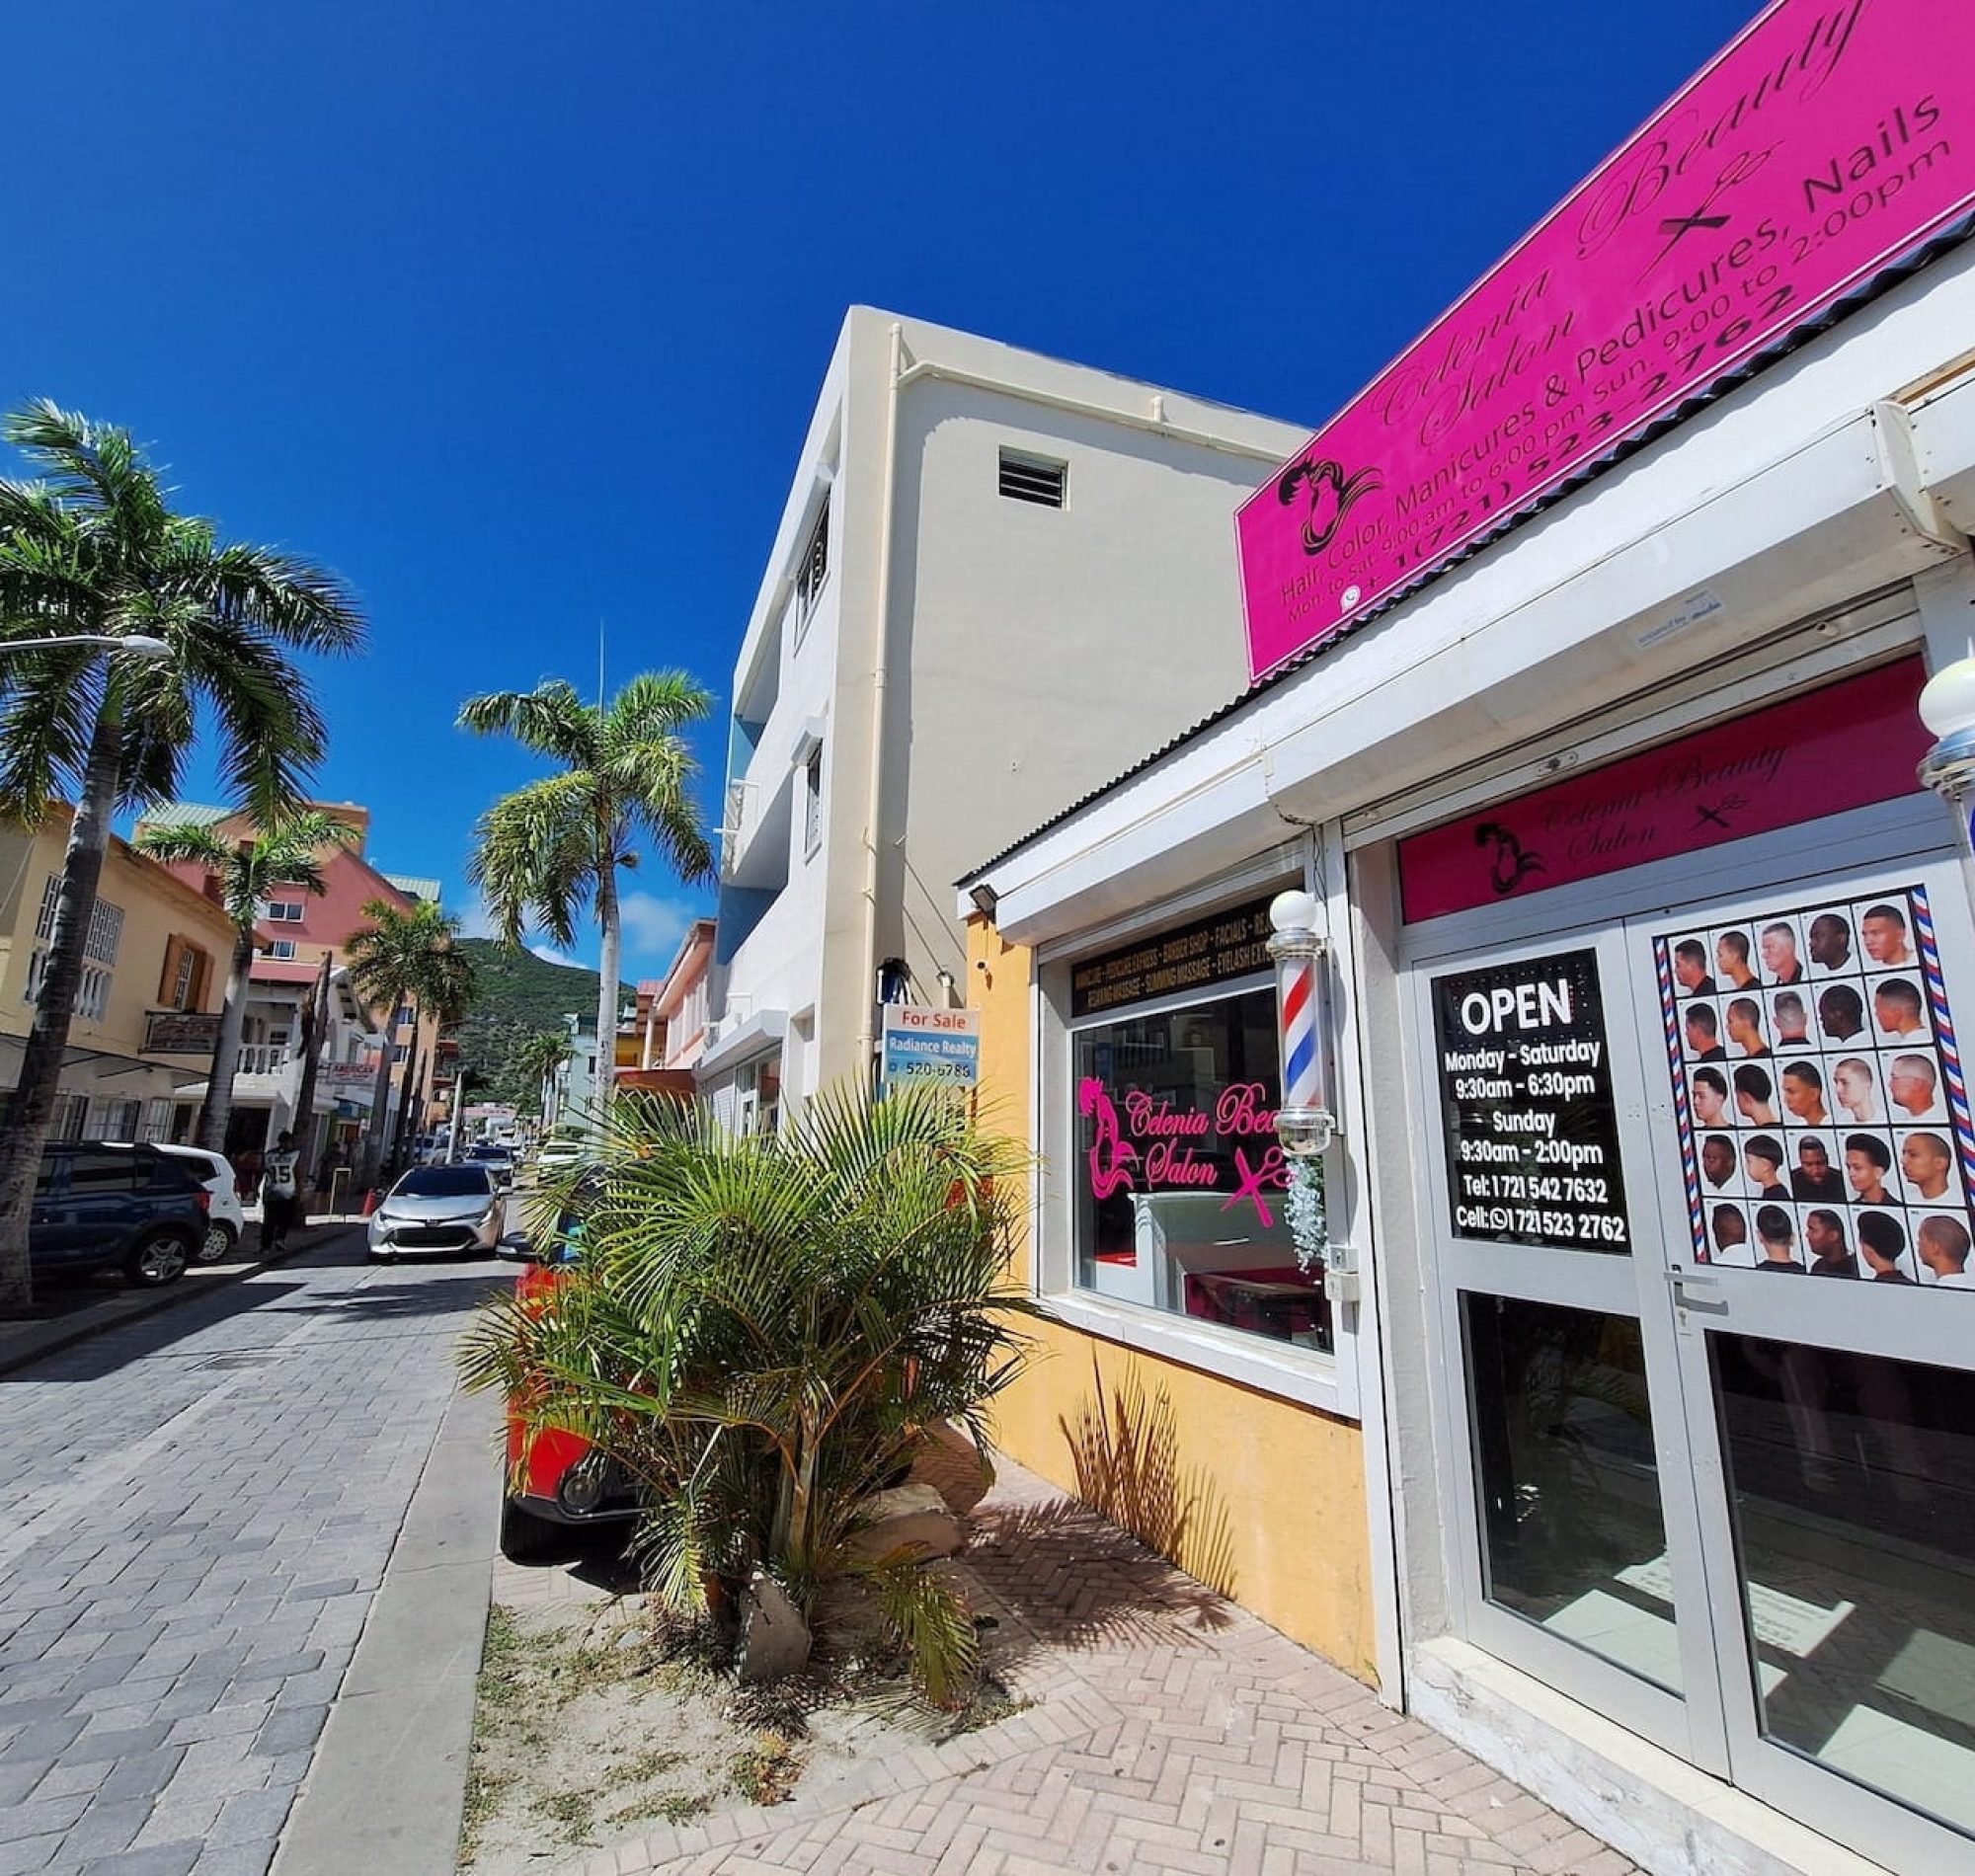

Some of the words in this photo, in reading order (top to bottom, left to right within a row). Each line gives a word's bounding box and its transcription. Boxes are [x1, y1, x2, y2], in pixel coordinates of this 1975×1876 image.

[1577, 0, 1864, 261] Beauty
[1393, 400, 1537, 517] Manicures
[1544, 373, 1569, 409] &
[1576, 215, 1791, 384] Pedicures,
[1801, 93, 1941, 214] Nails
[1328, 577, 1344, 596] to
[1382, 520, 1419, 554] 9:00
[1424, 497, 1457, 528] am
[1461, 475, 1483, 501] to
[1488, 435, 1537, 480] 6:00
[1543, 403, 1585, 448] pm
[1592, 356, 1655, 406] Sun.
[1662, 293, 1730, 352] 9:00
[1742, 264, 1778, 298] to
[1790, 139, 1951, 267] 2:00pm
[1420, 310, 1574, 449] Salon
[903, 1010, 928, 1027] For
[933, 1013, 966, 1030] Sale
[1461, 977, 1573, 1036] OPEN
[889, 1036, 940, 1054] Radiance
[942, 1039, 977, 1059] Realty
[1445, 1049, 1505, 1075] Monday
[1520, 1040, 1601, 1067] Saturday
[1455, 1077, 1513, 1100] 9:30am
[1528, 1072, 1596, 1102] 6:30pm
[1492, 1109, 1556, 1138] Sunday
[1146, 1137, 1218, 1192] Salon
[1461, 1140, 1520, 1163] 9:30am
[1535, 1140, 1604, 1172] 2:00pm
[1463, 1174, 1491, 1198] Tel:
[1529, 1176, 1562, 1202] 542
[1565, 1178, 1609, 1205] 7632
[1456, 1205, 1489, 1229] Cell:
[1542, 1211, 1575, 1236] 523
[1579, 1214, 1627, 1242] 2762
